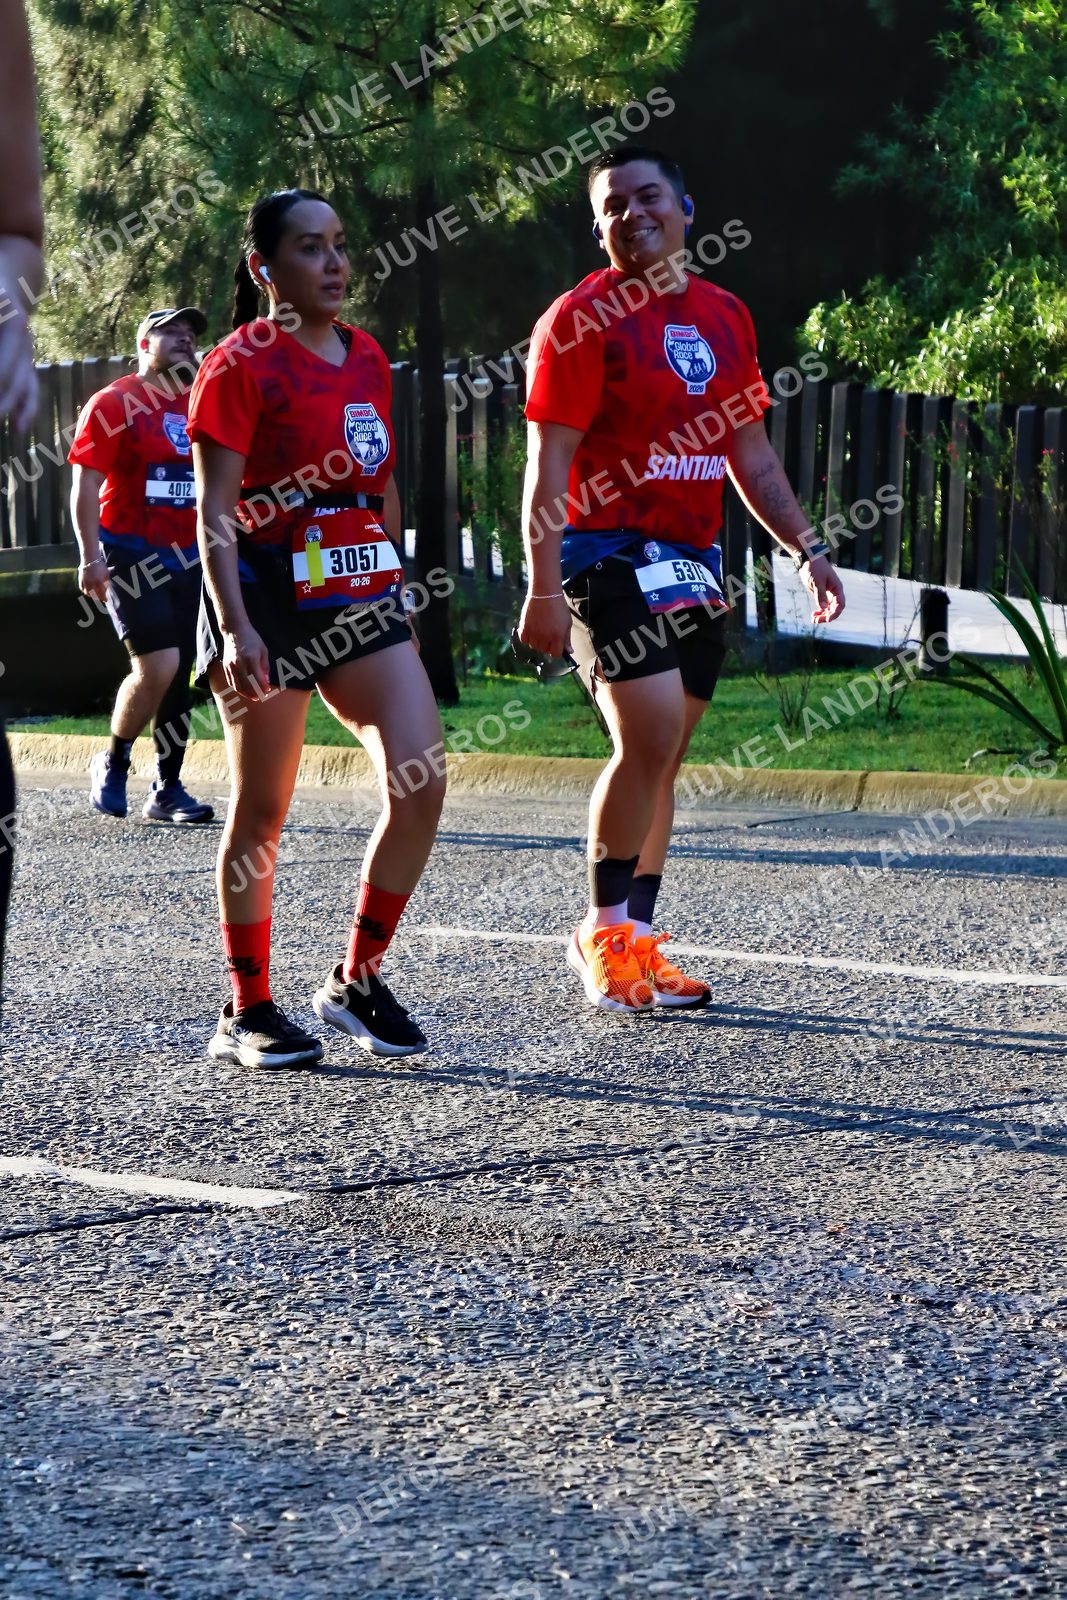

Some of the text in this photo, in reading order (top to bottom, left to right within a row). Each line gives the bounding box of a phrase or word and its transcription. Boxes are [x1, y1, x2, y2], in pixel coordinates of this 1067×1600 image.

[674, 342, 698, 352] Global
[673, 350, 693, 359] Race
[688, 384, 704, 393] 2026
[355, 421, 378, 432] Global
[353, 432, 372, 442] Race
[644, 454, 726, 480] SANTIAG
[168, 482, 192, 496] 4012
[330, 545, 378, 575] 3057
[350, 576, 370, 587] 20-26
